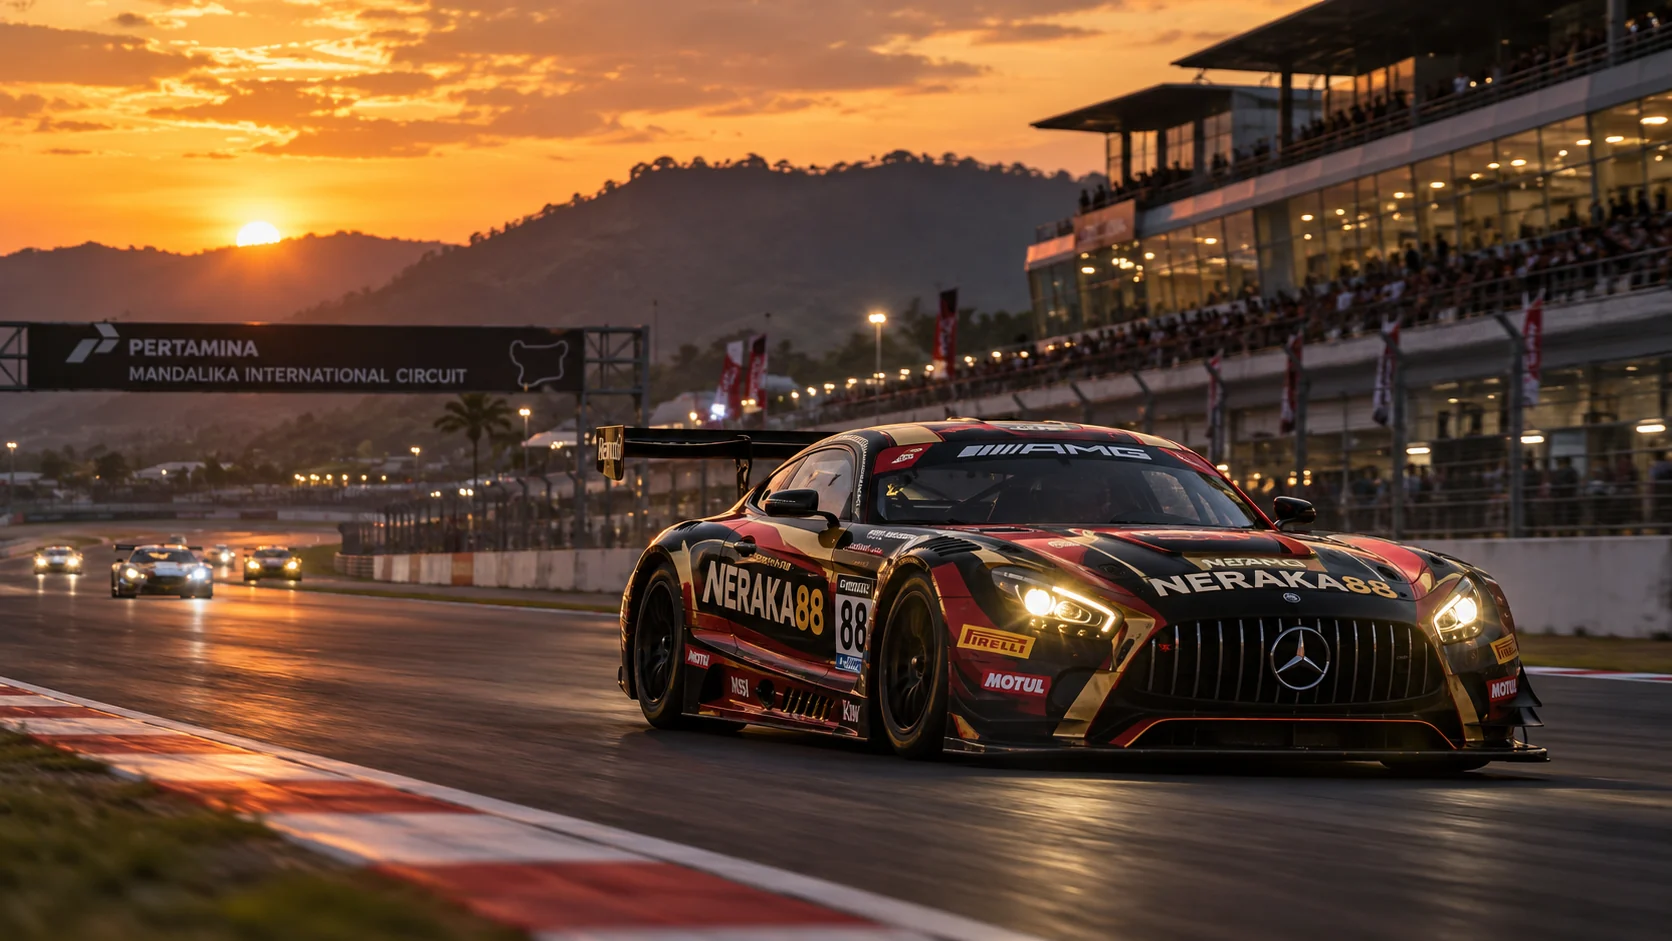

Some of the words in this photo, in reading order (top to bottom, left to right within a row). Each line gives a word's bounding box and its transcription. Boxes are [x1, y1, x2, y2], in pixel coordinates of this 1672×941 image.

[128, 338, 260, 358] PERTAMINA
[128, 366, 240, 382] MANDALIKA
[245, 367, 390, 383] INTERNATIONAL
[395, 367, 468, 384] CIRCUIT
[1018, 443, 1152, 460] AMG
[1149, 569, 1399, 599] NERAKA88
[701, 560, 824, 636] NERAKA88
[840, 599, 868, 653] 88
[963, 628, 1028, 654] PIRELLI
[984, 672, 1045, 694] MOTUL
